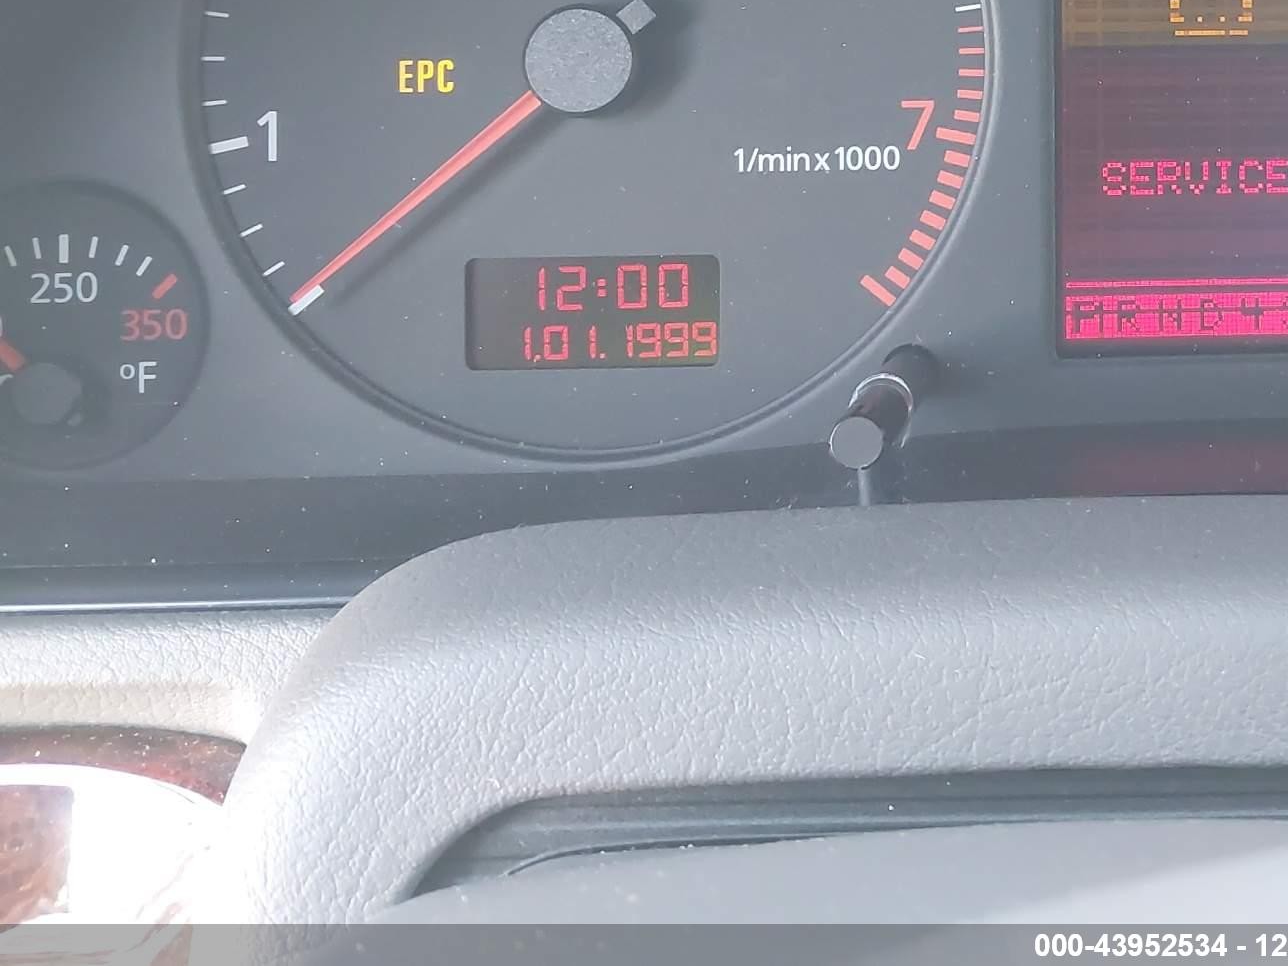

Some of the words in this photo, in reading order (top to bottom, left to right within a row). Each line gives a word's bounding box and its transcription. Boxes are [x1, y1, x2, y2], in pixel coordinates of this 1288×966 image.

[397, 59, 455, 94] EPC
[257, 110, 278, 162] 1
[899, 99, 936, 151] 7
[30, 271, 99, 304] 250
[538, 263, 690, 311] 12:00
[119, 308, 189, 342] 350
